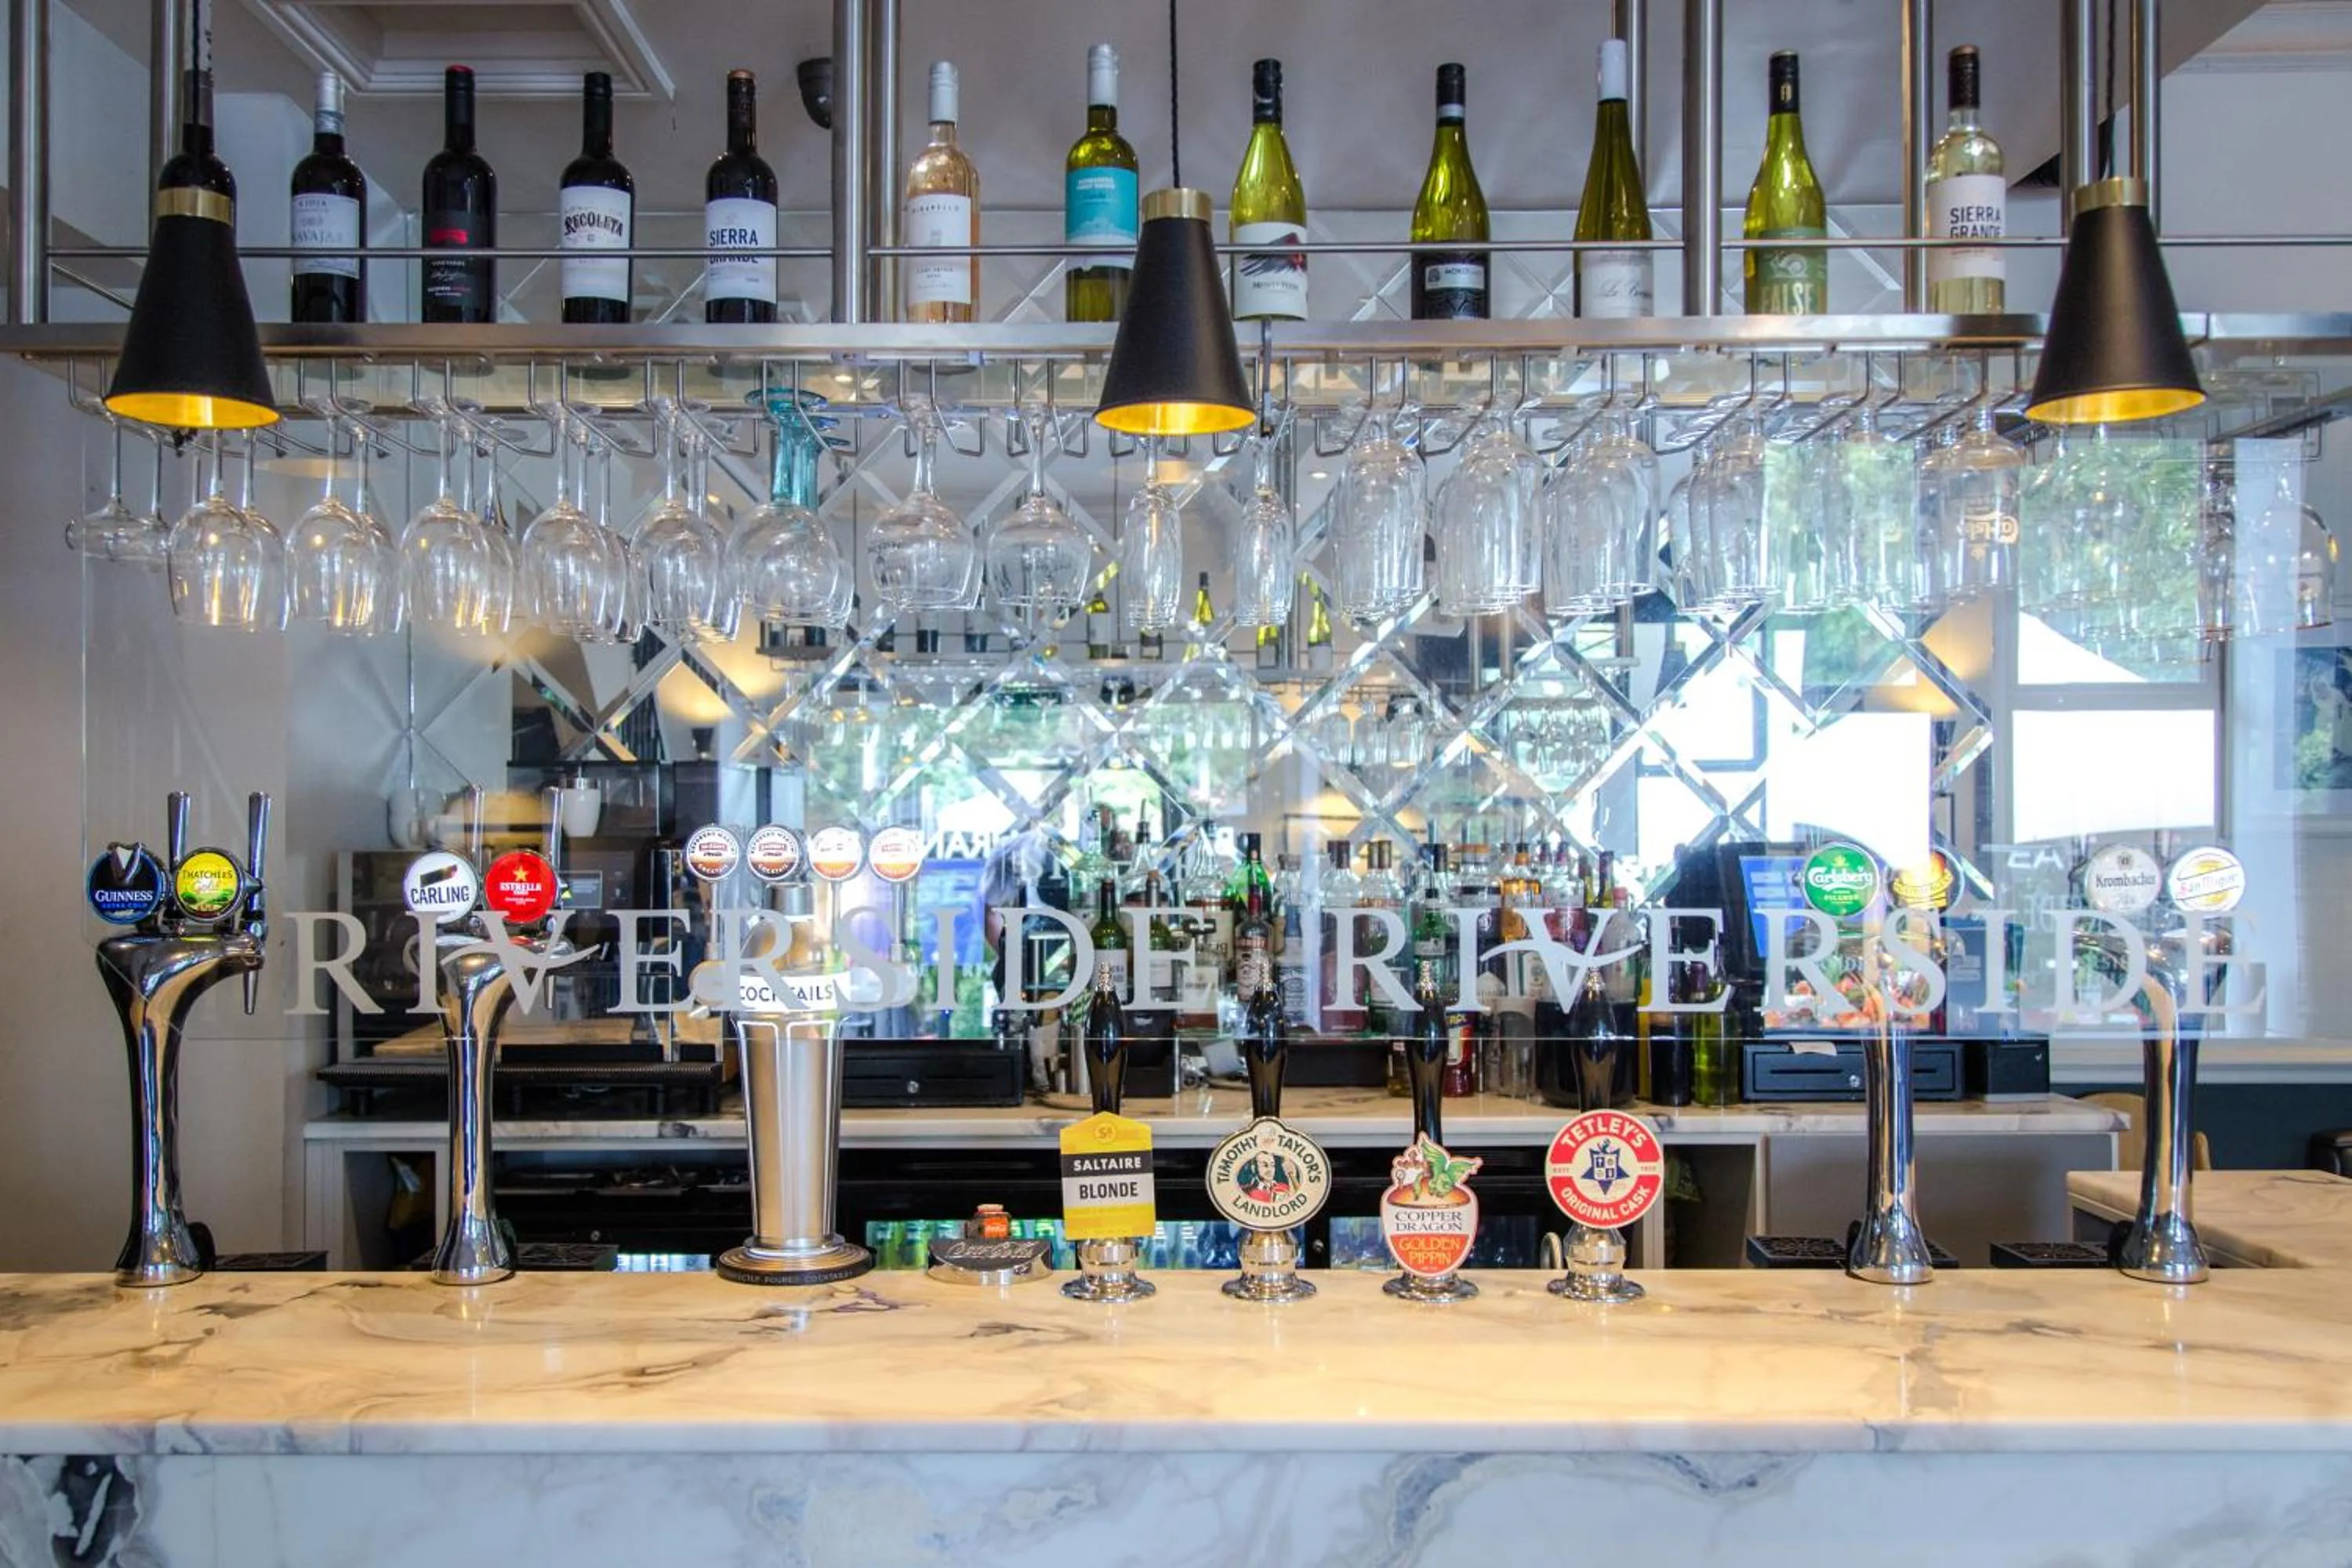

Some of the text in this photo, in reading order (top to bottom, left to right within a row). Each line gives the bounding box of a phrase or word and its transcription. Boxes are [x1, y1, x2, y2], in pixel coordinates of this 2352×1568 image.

[564, 211, 624, 238] RECOLETA
[1949, 205, 2002, 225] SIERRA
[709, 227, 759, 248] SIERRA
[499, 882, 543, 892] ESTRELLA
[1808, 866, 1874, 891] Carlsberg
[2095, 873, 2156, 888] Krombacher
[95, 889, 154, 902] GUINNESS
[409, 885, 470, 905] CARLING
[283, 906, 1209, 1014] RIVERSIDE
[1323, 907, 2267, 1014] RIVERSIDE
[1560, 1116, 1648, 1149] TETLEY'S
[1073, 1156, 1142, 1171] SALTAIRE
[1217, 1134, 1321, 1185] TIMOTHY TAYLOR'S
[1079, 1181, 1138, 1200] BLONDE
[1232, 1192, 1308, 1218] LANDLORD
[1561, 1185, 1651, 1221] ORIGINAL CASK
[1394, 1211, 1462, 1222] COPPER
[1396, 1222, 1462, 1232] DRAGON
[1399, 1237, 1461, 1250] GOLDEN
[1408, 1251, 1451, 1265] PIPPIN
